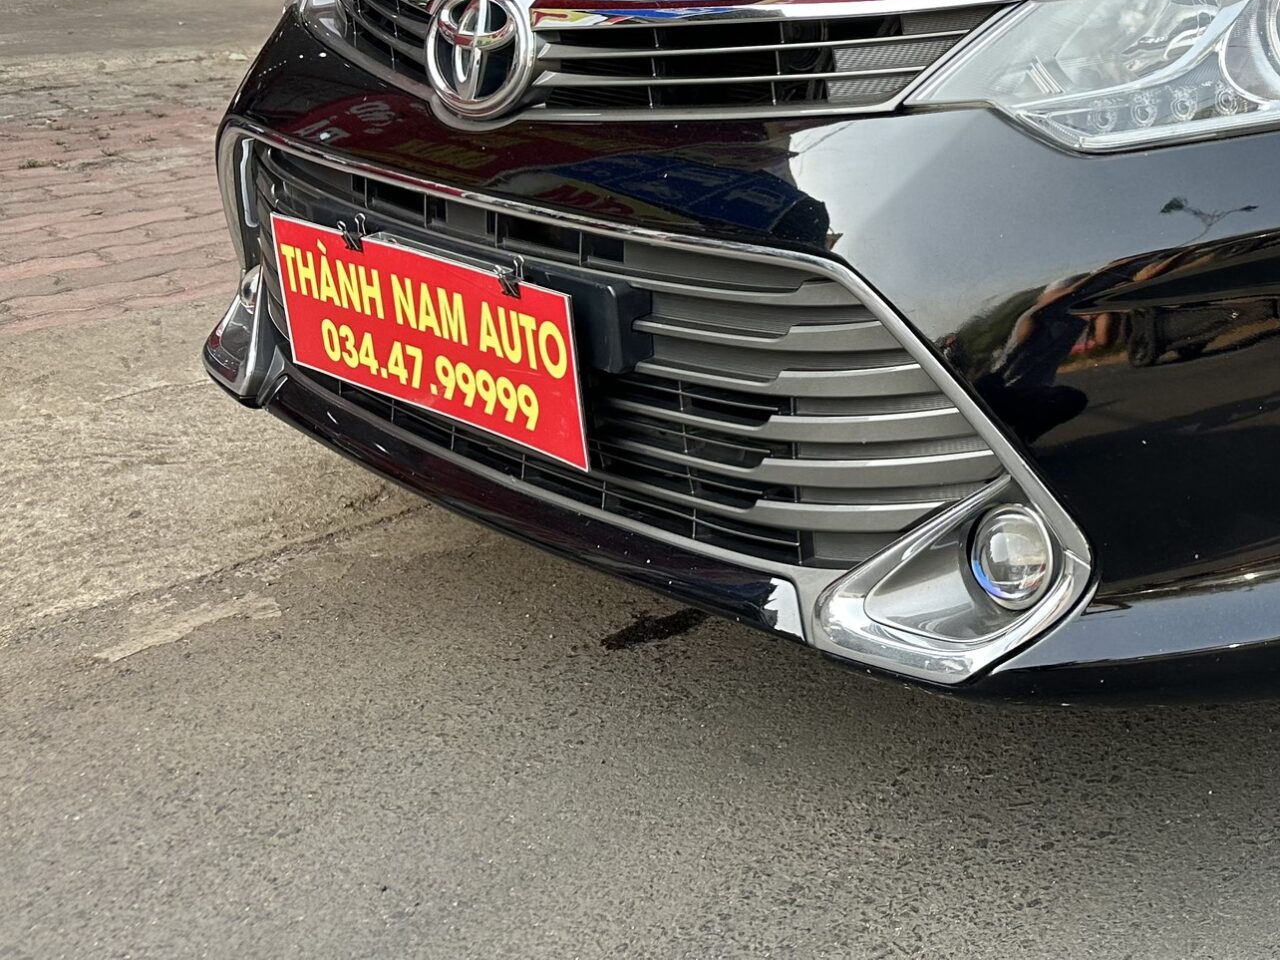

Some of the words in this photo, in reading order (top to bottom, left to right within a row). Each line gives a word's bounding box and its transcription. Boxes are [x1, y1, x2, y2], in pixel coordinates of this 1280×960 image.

[280, 240, 384, 319] THÀNH
[391, 274, 468, 346] NAM
[479, 301, 567, 379] AUTO
